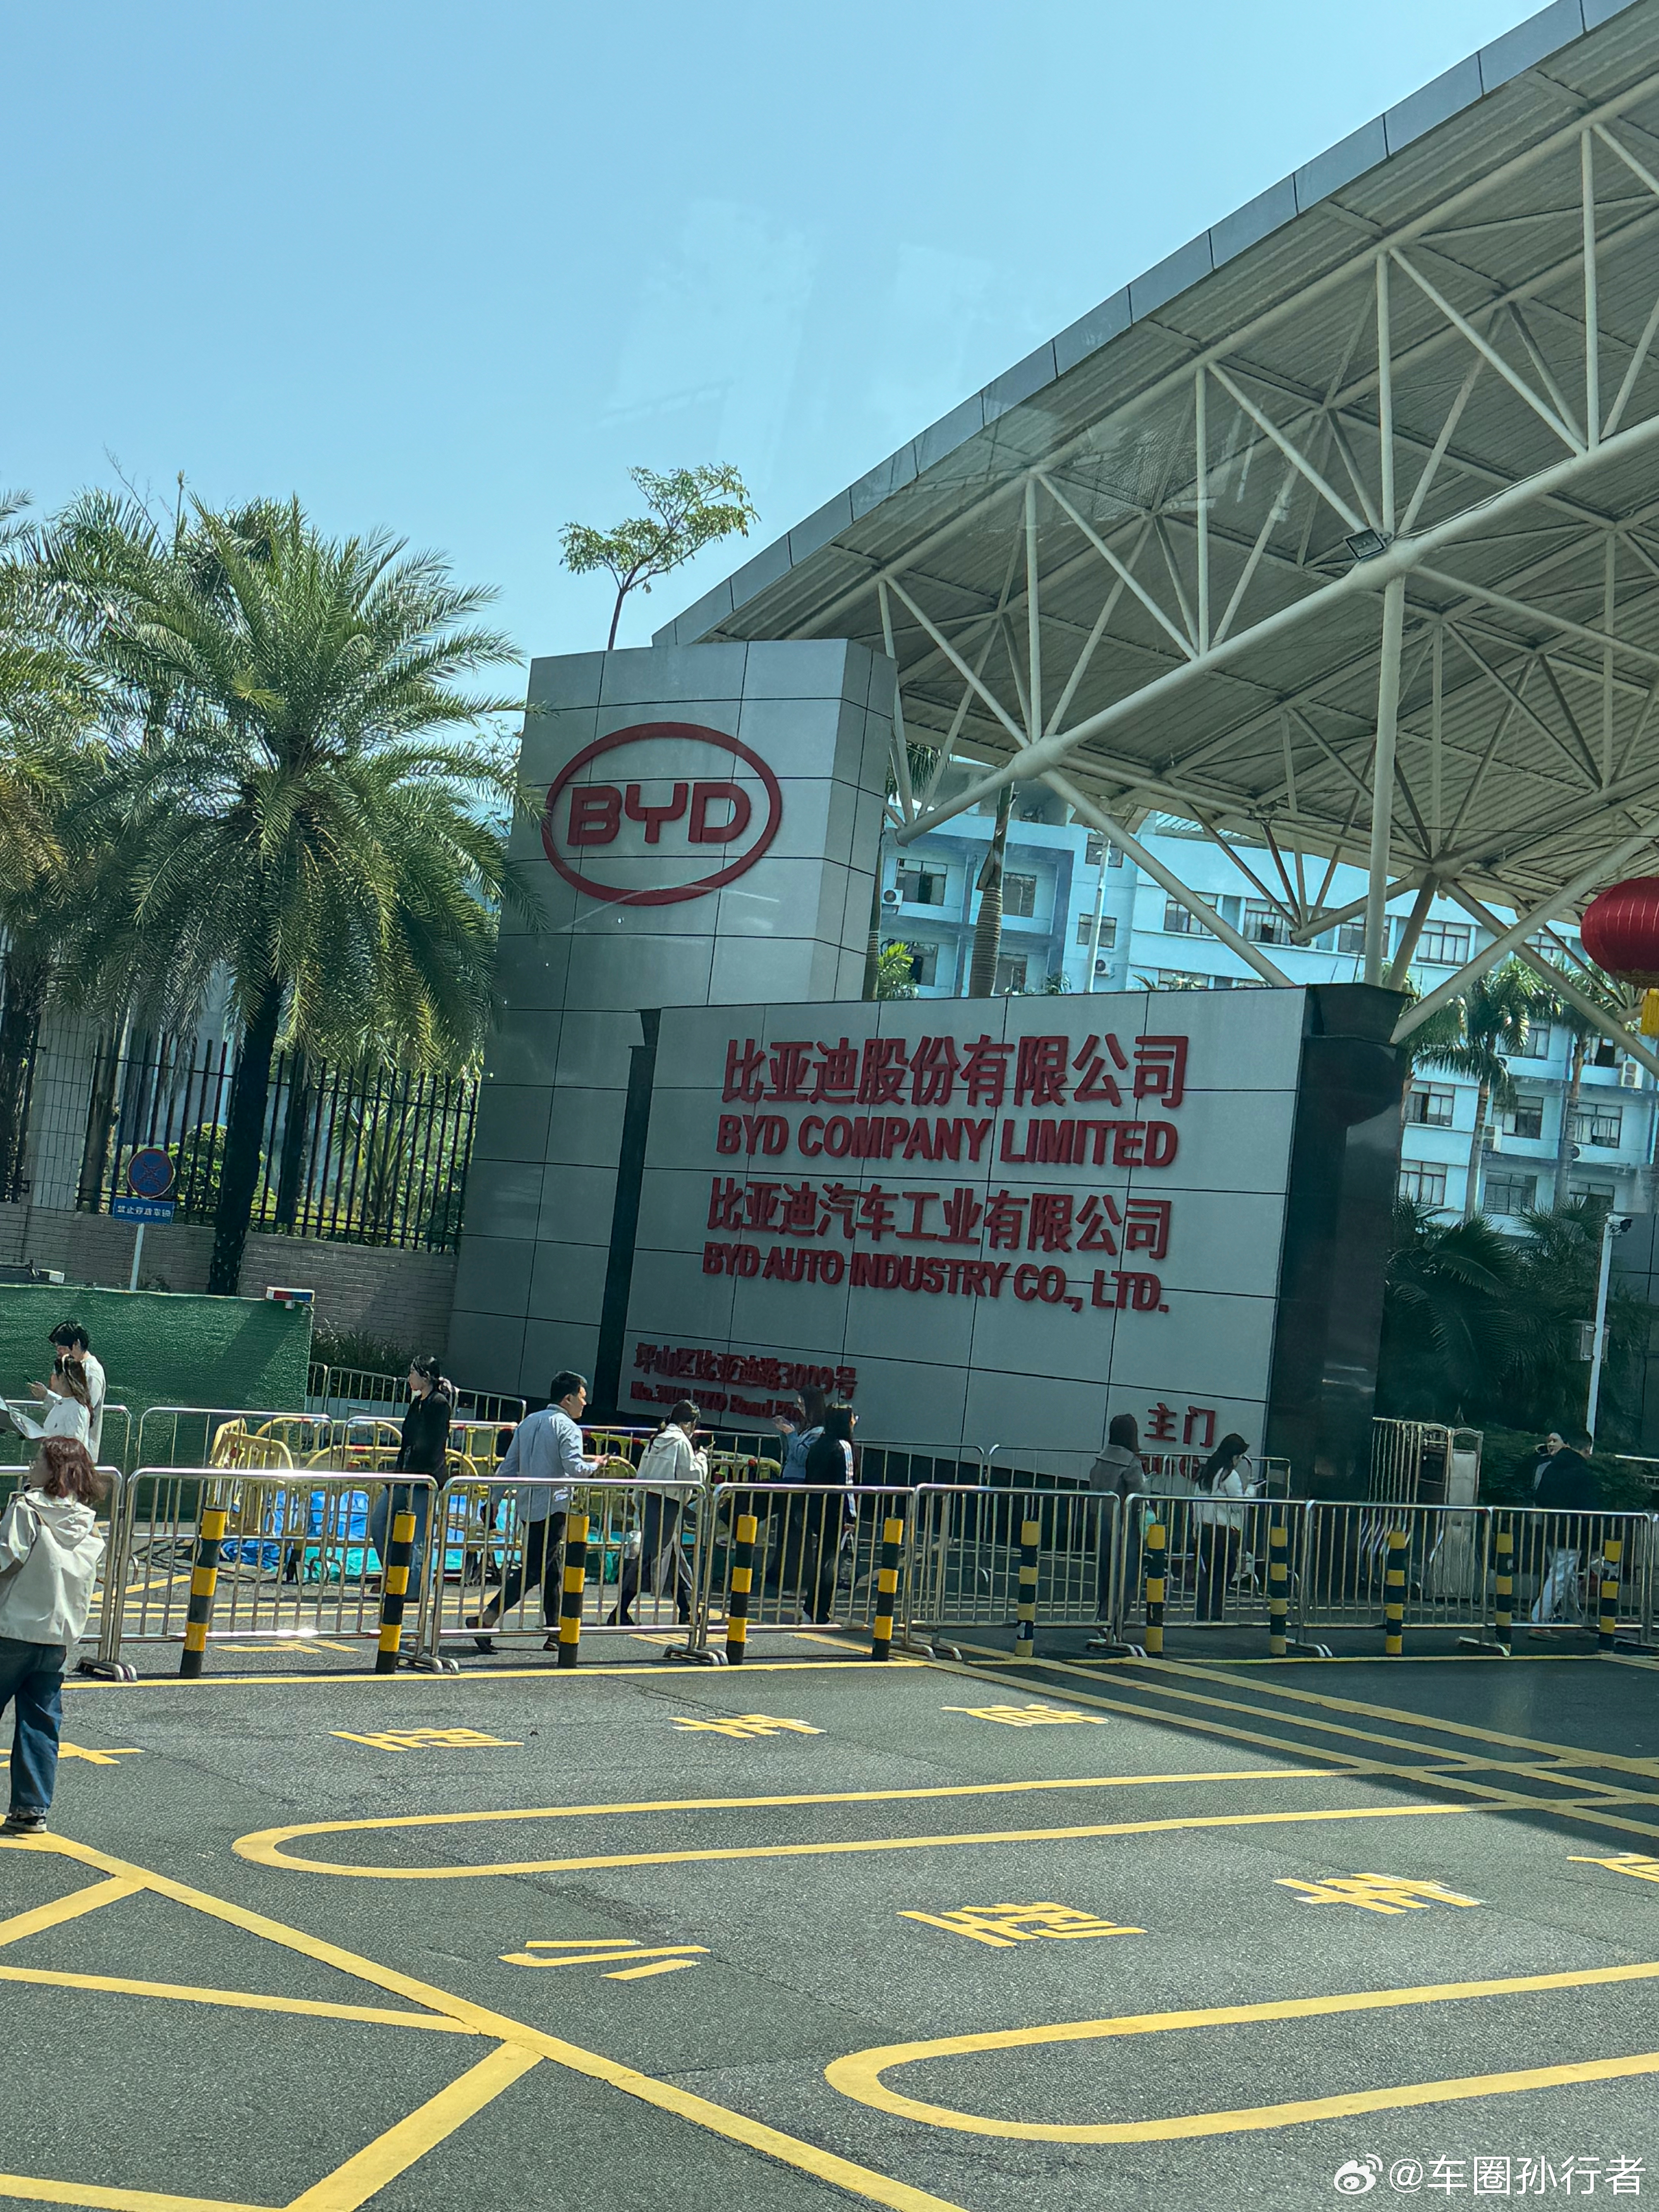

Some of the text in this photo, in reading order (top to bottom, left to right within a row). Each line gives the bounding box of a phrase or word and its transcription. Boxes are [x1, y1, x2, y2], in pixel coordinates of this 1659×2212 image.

[567, 782, 751, 846] BYD
[723, 1034, 1189, 1108] 比亚迪股份有限公司
[716, 1114, 1178, 1167] BYD COMPANY LIMITED
[706, 1177, 1172, 1259] 比亚迪汽车工业有限公司
[702, 1242, 760, 1277] BYD
[762, 1247, 845, 1285] AUTO
[849, 1252, 1011, 1298] INDUSTRY
[1092, 1269, 1169, 1313] LTD.
[1144, 1402, 1215, 1448] 主门
